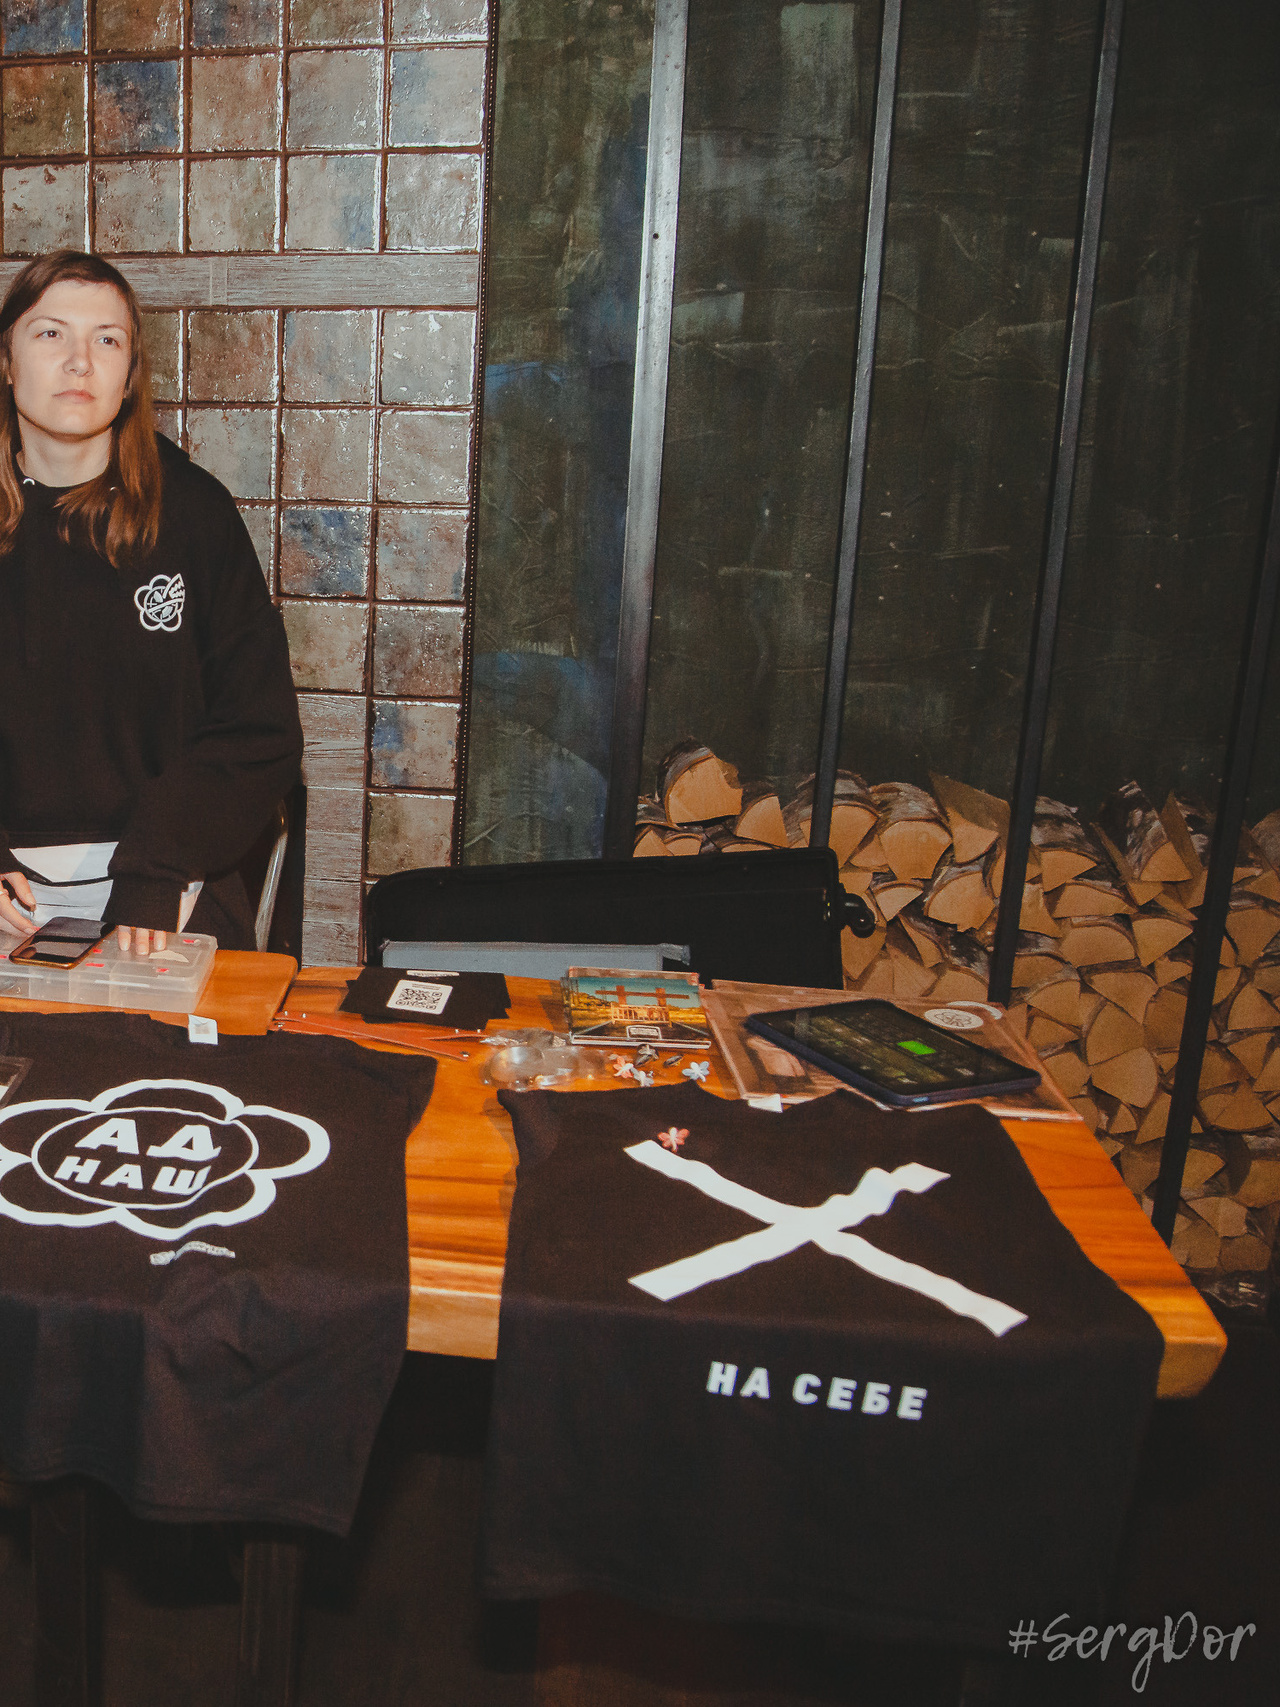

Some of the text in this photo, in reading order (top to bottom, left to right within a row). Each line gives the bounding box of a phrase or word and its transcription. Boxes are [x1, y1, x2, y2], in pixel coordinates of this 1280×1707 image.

[74, 1117, 222, 1162] АД
[53, 1155, 212, 1196] НАШ
[705, 1360, 928, 1421] НА СЕБЕ
